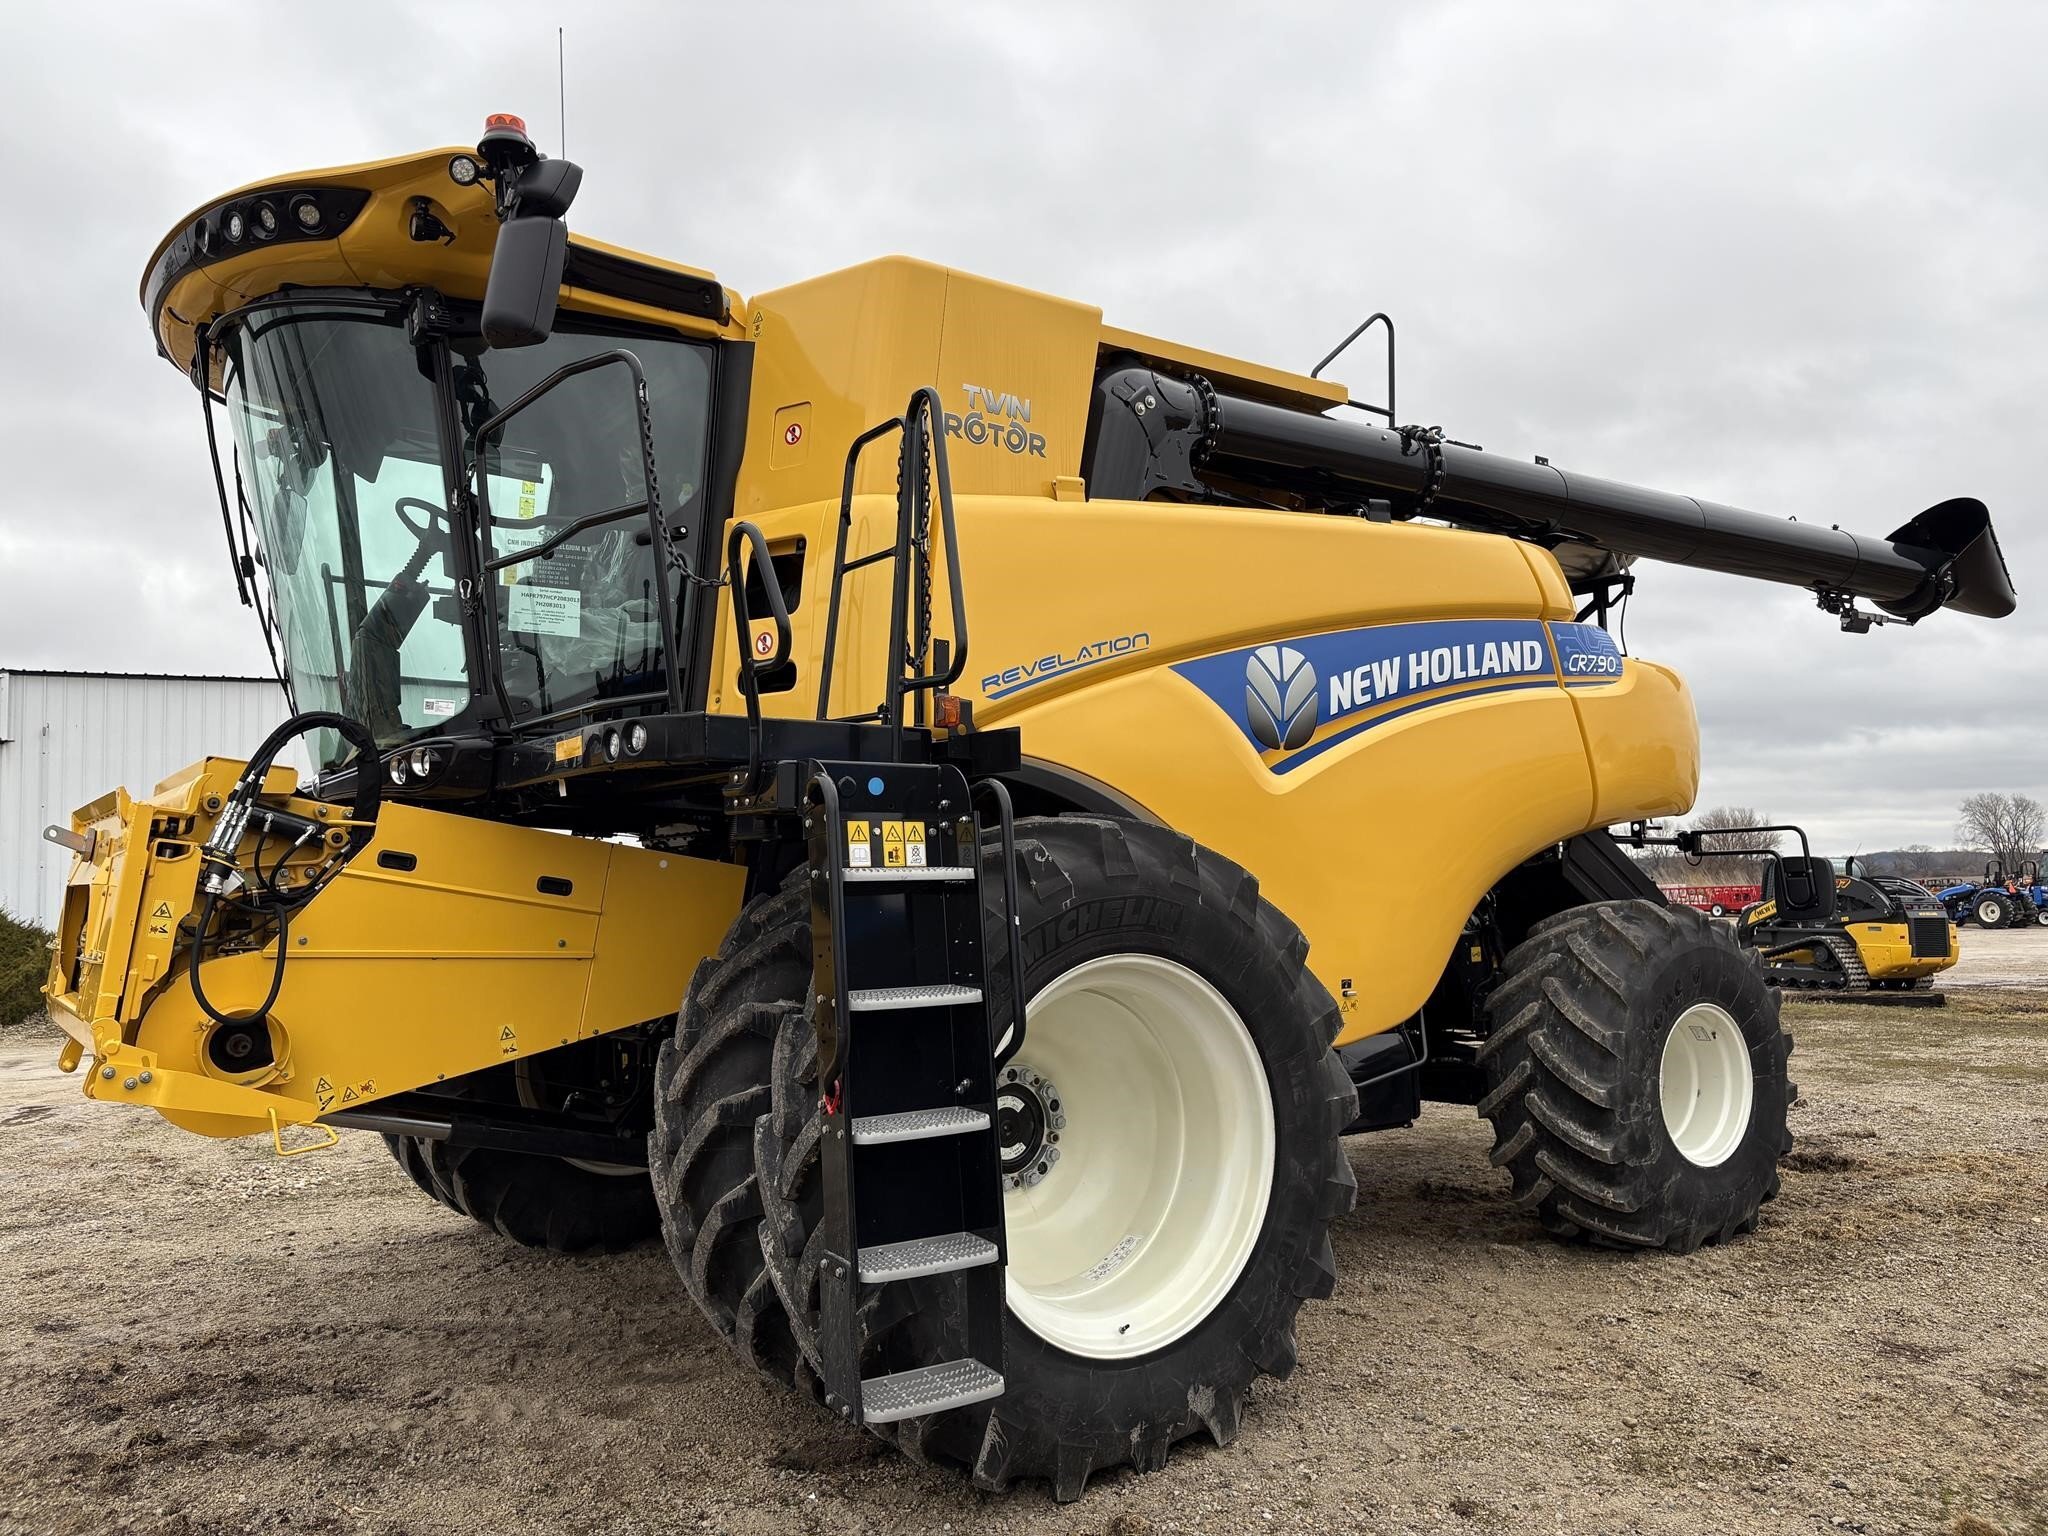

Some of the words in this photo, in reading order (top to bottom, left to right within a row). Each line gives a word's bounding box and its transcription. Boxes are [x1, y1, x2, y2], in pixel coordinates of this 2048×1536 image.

[963, 383, 1031, 422] TWIN
[945, 411, 1047, 458] ROTOR
[981, 632, 1149, 692] REVELATION
[1329, 656, 1400, 716] NEW
[1408, 639, 1544, 689] HOLLAND
[1568, 654, 1617, 673] CR7.90
